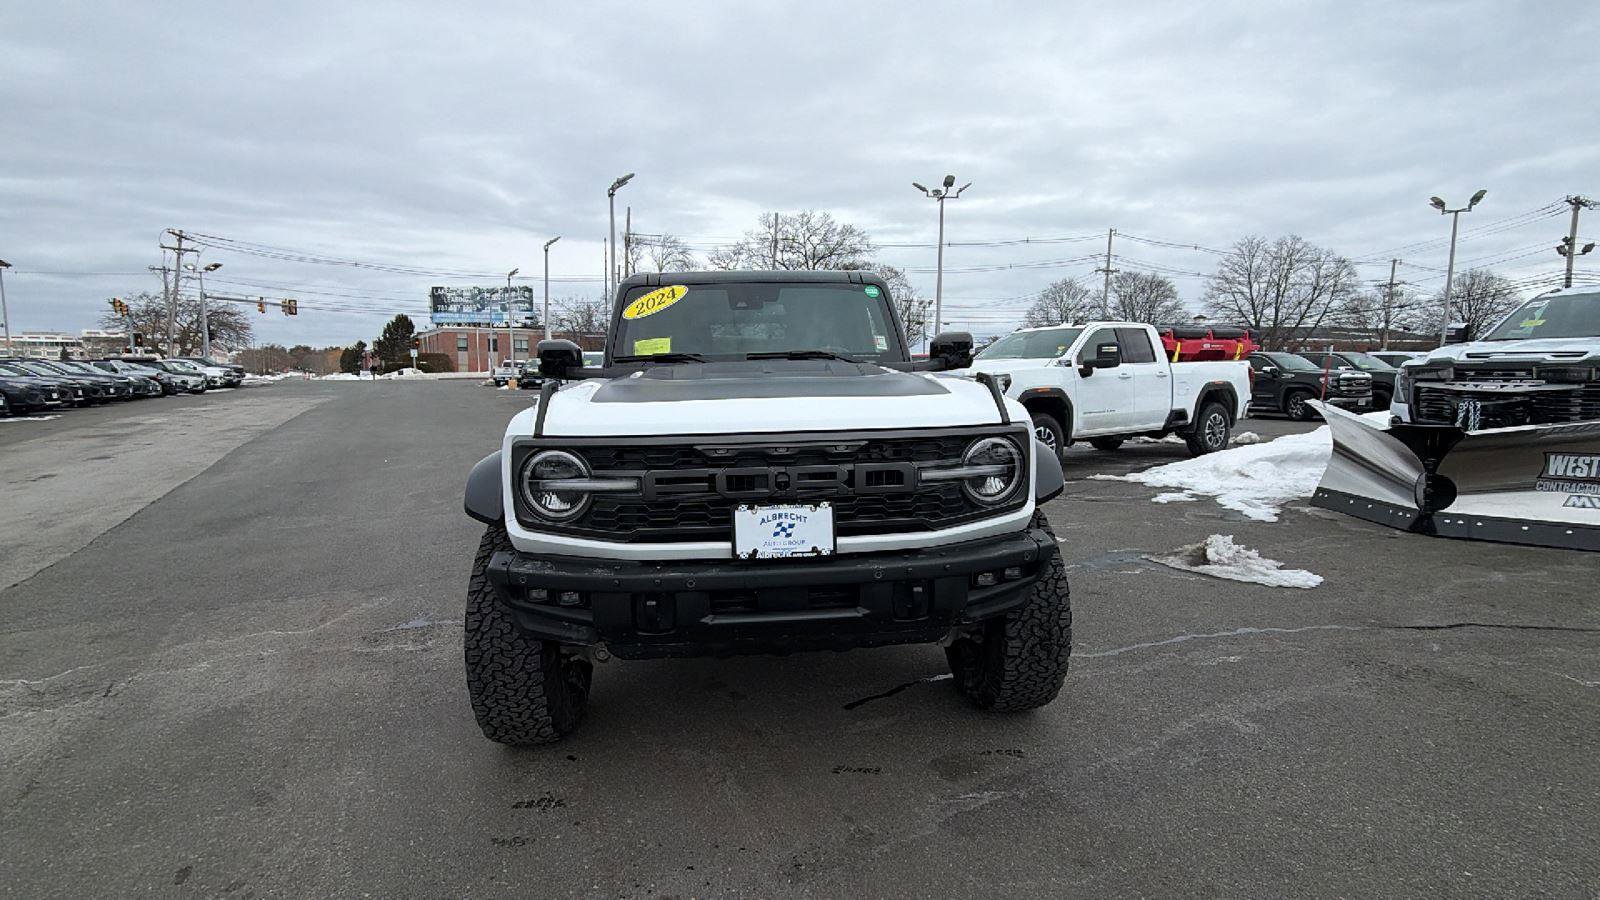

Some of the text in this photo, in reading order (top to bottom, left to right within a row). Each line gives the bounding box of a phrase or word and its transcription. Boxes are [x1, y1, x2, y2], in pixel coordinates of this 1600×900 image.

[635, 287, 677, 315] 2024
[645, 462, 915, 499] FORD
[760, 512, 808, 525] ALBRECHT
